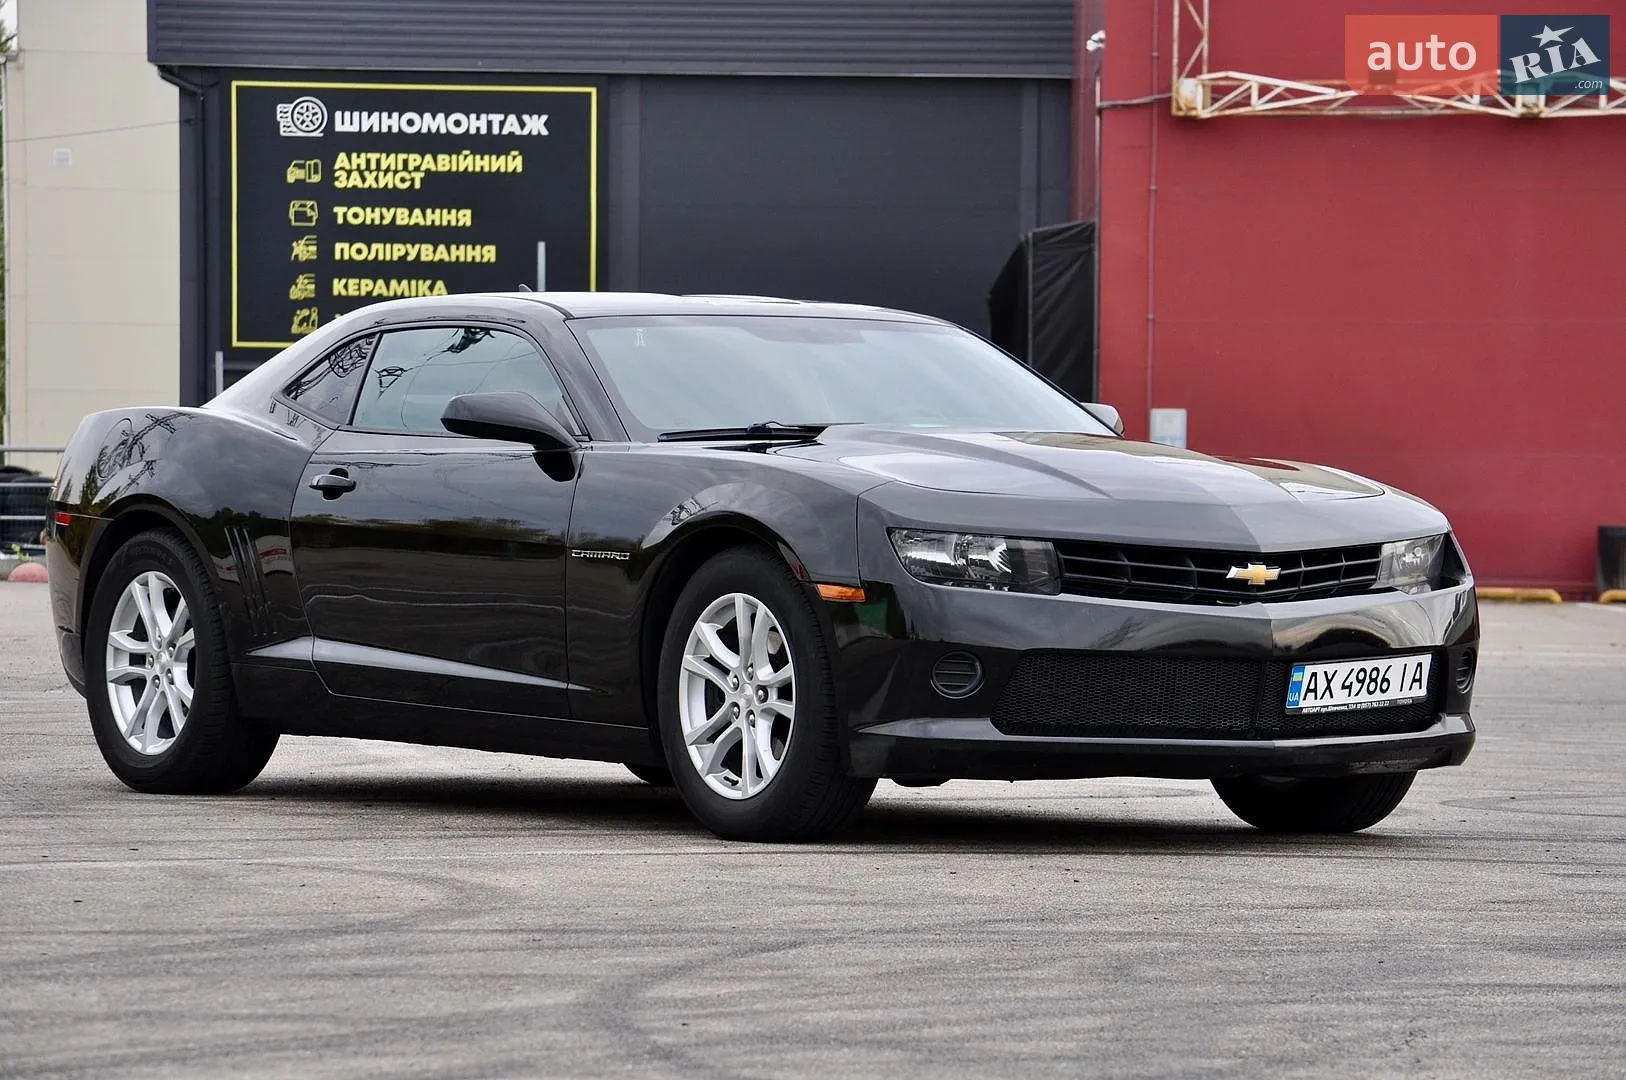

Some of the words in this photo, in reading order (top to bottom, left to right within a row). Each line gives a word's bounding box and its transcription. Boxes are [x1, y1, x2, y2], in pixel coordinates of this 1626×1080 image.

[334, 110, 549, 136] ШИНОМОНТАЖ
[333, 150, 523, 173] АНТИГРАВІЙНИЙ
[333, 171, 425, 190] ЗАХИСТ
[333, 206, 472, 227] ТОНУВАННЯ
[334, 242, 497, 264] ПОЛІРУВАННЯ
[332, 278, 448, 297] КЕРАМІКА
[571, 549, 630, 560] CAMARO
[1303, 669, 1338, 700] AX
[1341, 665, 1392, 697] 4986
[1399, 662, 1423, 692] IA
[1288, 692, 1299, 702] UA
